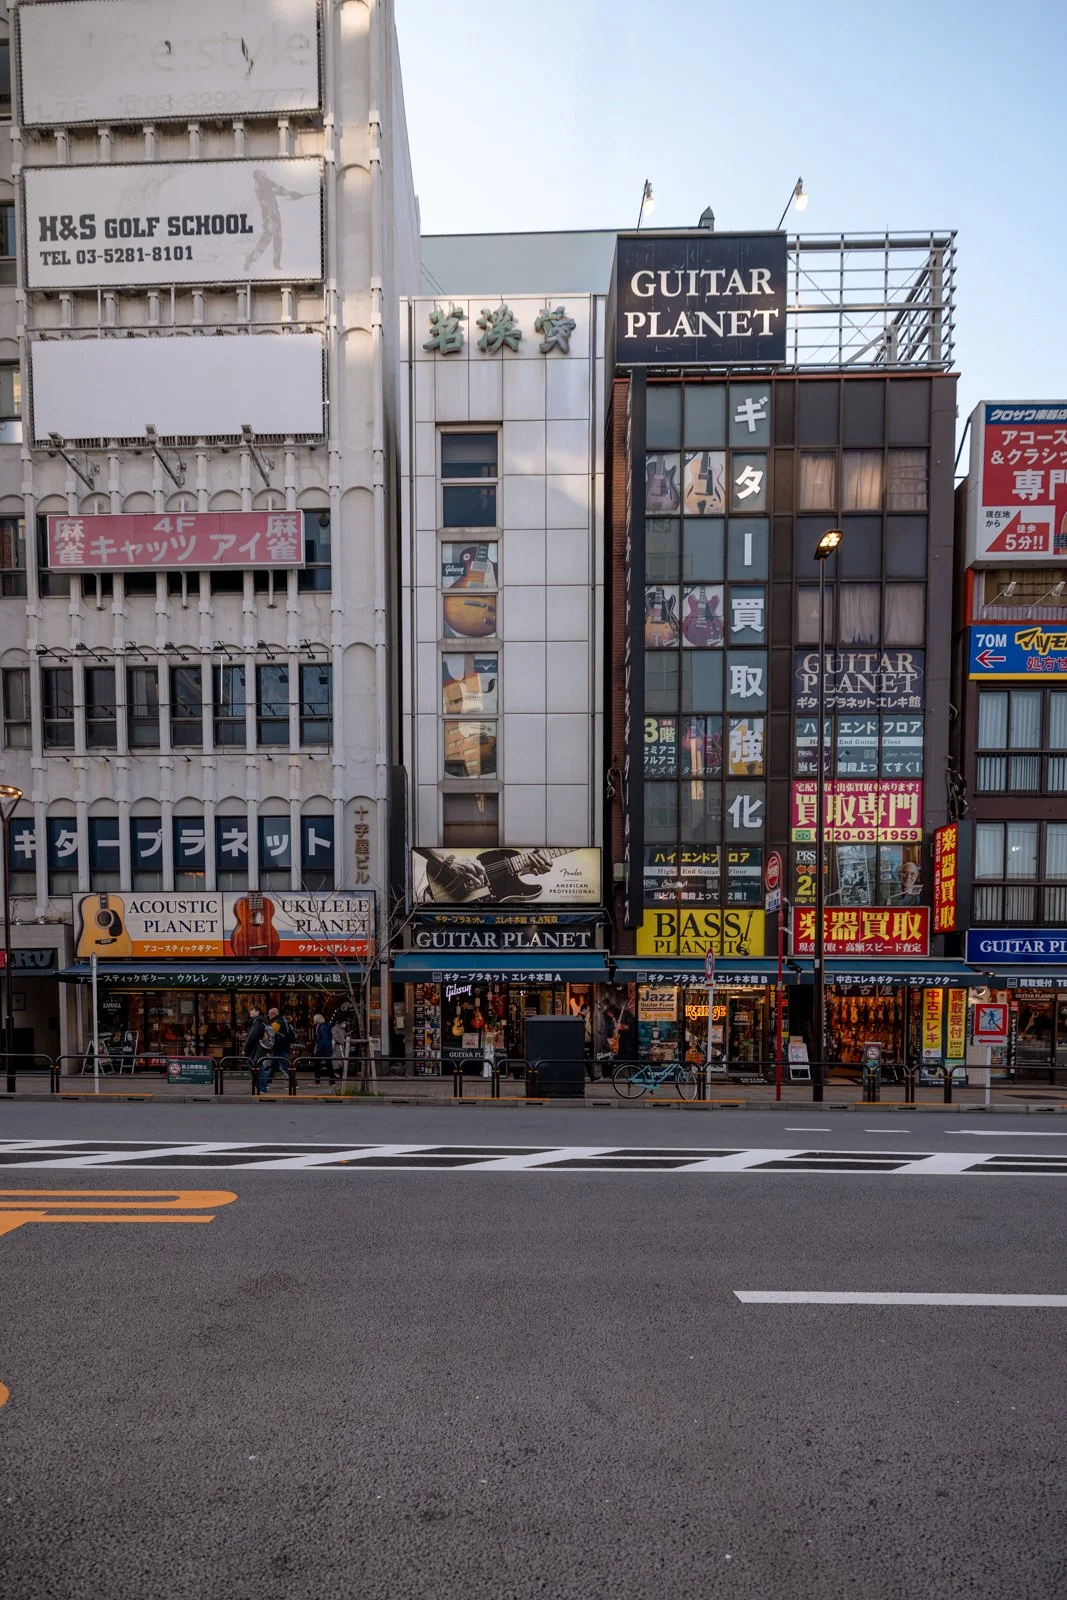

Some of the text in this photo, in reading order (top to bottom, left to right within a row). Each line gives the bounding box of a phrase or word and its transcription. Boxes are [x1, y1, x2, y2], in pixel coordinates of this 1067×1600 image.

[39, 213, 253, 242] H&S GOLF SCHOOL
[40, 246, 193, 266] TEL 03-5281-8101
[630, 268, 775, 297] GUITAR
[624, 308, 779, 338] PLANET
[986, 511, 1010, 519] 現在地
[153, 516, 195, 533] 4F
[986, 519, 1000, 527] から
[1017, 524, 1036, 533] 徒歩
[54, 518, 86, 565] 麻雀
[266, 515, 297, 561] 麻雀
[89, 533, 261, 563] キャッツ アイ
[976, 634, 1007, 647] 70M
[803, 653, 915, 674] GUITAR
[802, 673, 918, 693] PLANET
[797, 696, 921, 709] ギタプラネットエレキ館
[796, 793, 919, 827] 買取専門
[814, 830, 918, 841] 120-03-1959
[354, 805, 371, 886] 十字屋ビル
[796, 850, 816, 860] PRS
[128, 900, 217, 915] ACOUSTIC
[281, 900, 369, 914] UKULELE
[144, 920, 217, 934] PLANET
[296, 920, 369, 933] PLANET
[653, 912, 741, 938] BASS
[416, 932, 591, 948] GUITAR PLANET
[654, 940, 738, 953] PLANET
[980, 940, 1045, 953] GUITAR
[143, 943, 219, 953] アコースティックギター
[443, 973, 508, 982] ギタープラネット
[648, 973, 713, 983] ギタープラネッ
[446, 984, 472, 1001] Gibson
[641, 990, 675, 1002] Jazz
[926, 990, 940, 1043] 中古エレキ
